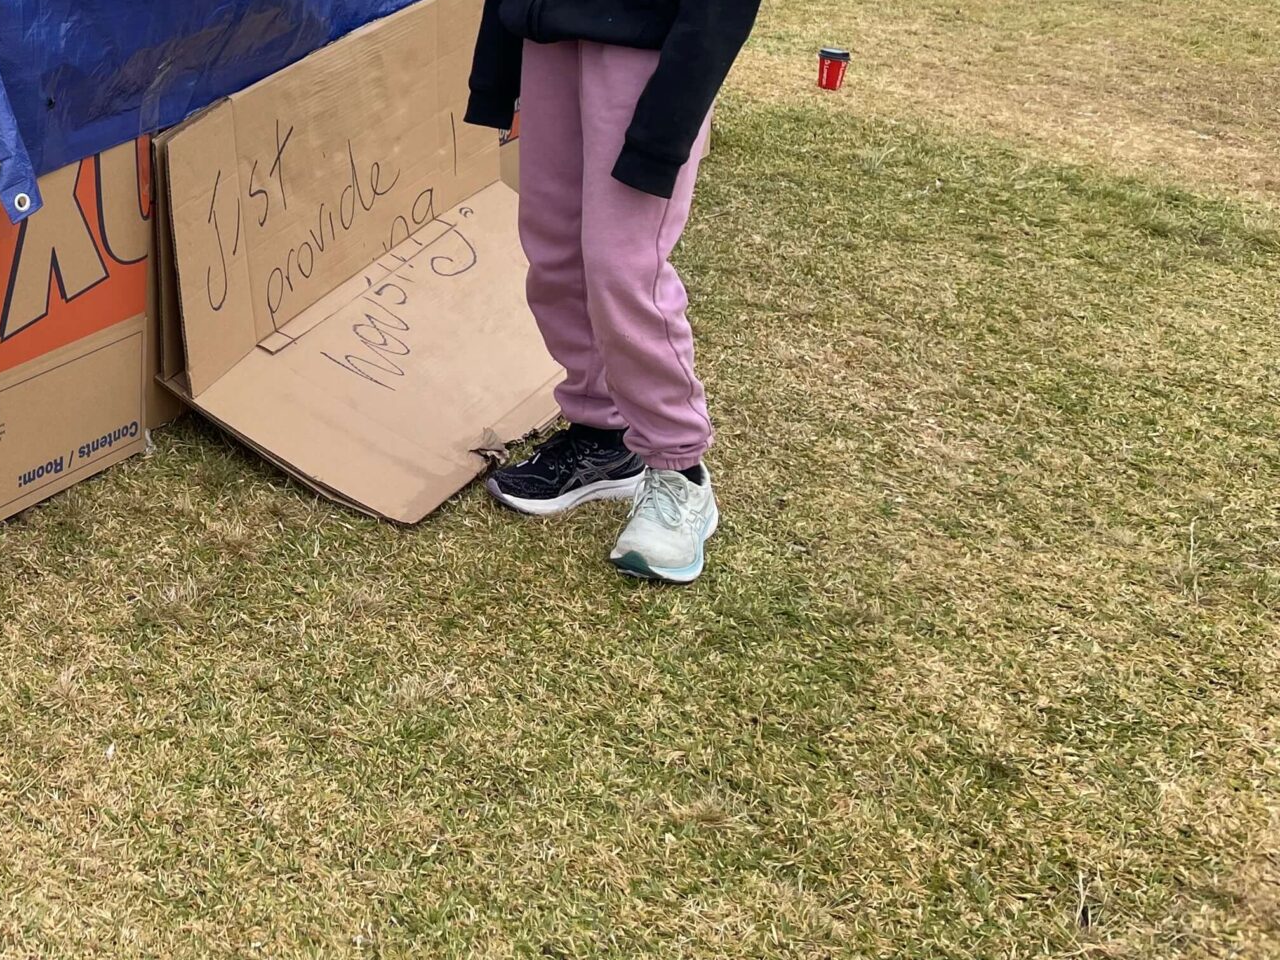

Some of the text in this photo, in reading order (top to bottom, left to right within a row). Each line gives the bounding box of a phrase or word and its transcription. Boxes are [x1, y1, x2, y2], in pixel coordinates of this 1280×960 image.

[267, 138, 401, 342] provide
[78, 421, 139, 458] Contents
[18, 456, 64, 488] Room:
